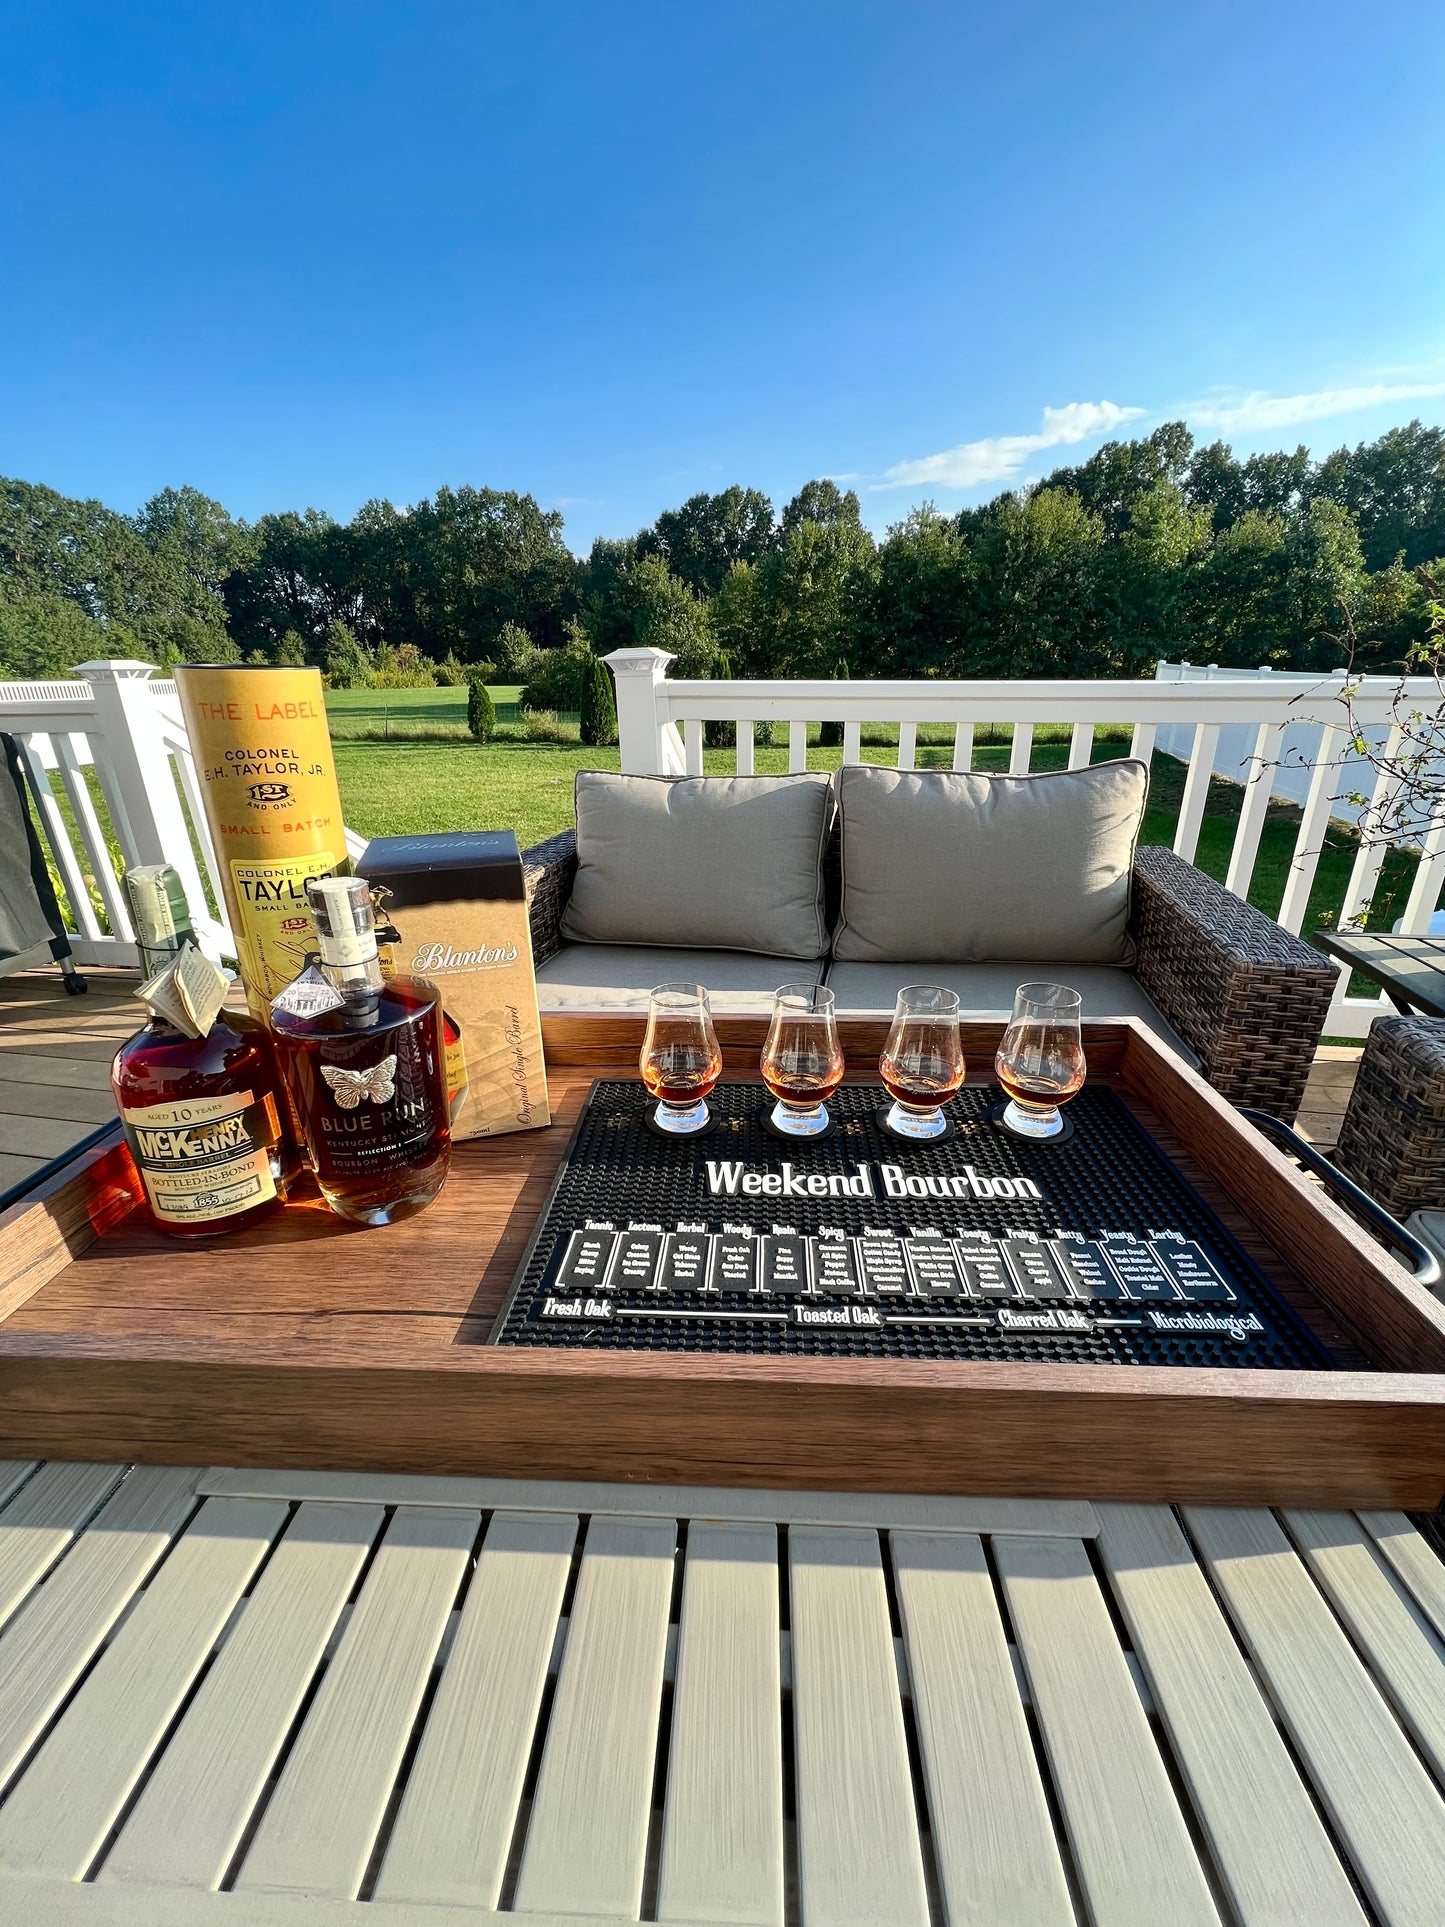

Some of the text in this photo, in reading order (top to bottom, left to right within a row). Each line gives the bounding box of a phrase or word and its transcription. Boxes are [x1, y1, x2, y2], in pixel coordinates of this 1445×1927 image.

[198, 701, 318, 720] THE LABEL
[225, 749, 299, 761] COLONEL
[204, 762, 326, 781] E.H. TAYLOR, JR.
[252, 783, 284, 800] 1ST
[246, 798, 297, 811] AND ONLY
[220, 817, 331, 835] SMALL BATCH
[237, 863, 331, 878] COLONEL E.H.
[411, 941, 518, 972] Blanton's
[505, 1004, 537, 1124] Original Single Barrel
[147, 1104, 222, 1122] AGED 10 YEARS
[321, 1097, 425, 1132] BLUE RUN
[189, 1115, 245, 1141] HENRY
[327, 1138, 377, 1147] KENTUCKY
[357, 1144, 397, 1156] REFLECTION
[165, 1160, 196, 1168] SINGLE
[332, 1159, 378, 1167] BOURBON
[152, 1161, 255, 1187] BOTTLED-IN-BOND
[705, 1161, 1043, 1199] Weekend Bourbon
[194, 1195, 219, 1208] 1855
[627, 1221, 662, 1232] Lactone
[677, 1222, 706, 1234] Herbal
[723, 1223, 753, 1240] Woody
[772, 1224, 797, 1236] Resin
[818, 1225, 845, 1242] Spicy
[863, 1226, 894, 1238] Sweet
[909, 1227, 942, 1238] Vanilla
[956, 1227, 991, 1244] Toasty
[1005, 1228, 1039, 1244] Fruity
[1054, 1228, 1086, 1244] Nutty
[1099, 1229, 1137, 1245] Yeasty
[1148, 1229, 1187, 1245] Earthy
[825, 1261, 845, 1269] Pepper
[542, 1298, 612, 1317] Fresh Oak
[794, 1305, 880, 1325] Toasted Oak
[998, 1309, 1089, 1328] Charred Oak
[1148, 1311, 1265, 1341] Microbiological
